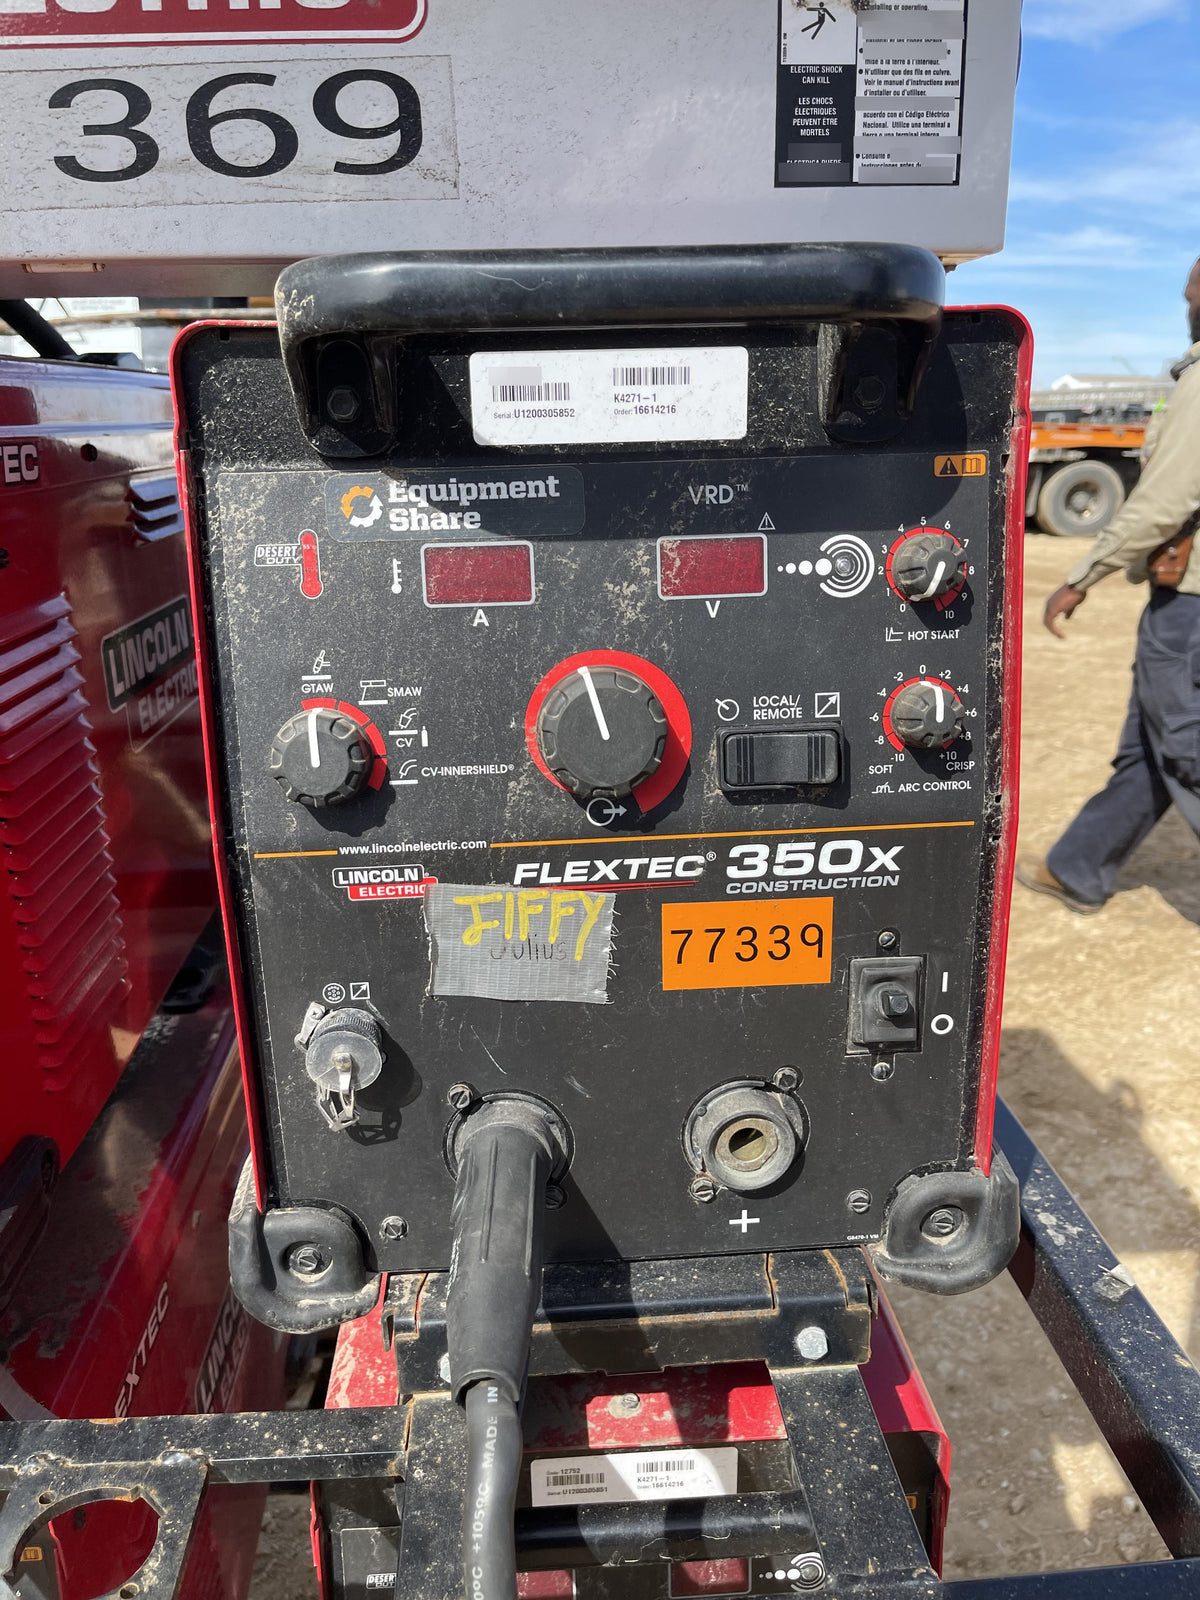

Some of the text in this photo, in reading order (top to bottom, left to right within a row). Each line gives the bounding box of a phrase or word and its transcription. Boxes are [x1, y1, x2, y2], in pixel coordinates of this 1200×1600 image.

[48, 69, 423, 183] 369
[514, 408, 575, 419] U1200305852
[634, 405, 676, 415] 16614216
[0, 444, 39, 484] EC
[388, 475, 560, 508] Equipment
[389, 507, 482, 532] Share
[921, 517, 926, 525] 5
[898, 524, 904, 532] 4
[944, 521, 950, 530] 6
[963, 539, 969, 548] 7
[257, 546, 297, 558] DESERT
[882, 546, 887, 554] 3
[878, 566, 884, 575] 2
[969, 565, 974, 574] 8
[886, 588, 890, 596] 1
[961, 592, 967, 601] 9
[705, 601, 720, 618] V
[900, 604, 906, 613] 0
[473, 610, 489, 627] A
[945, 610, 954, 619] 10
[907, 630, 960, 641] HOT START
[108, 608, 190, 697] LINCOLN
[920, 665, 926, 674] 0
[939, 670, 951, 679] +2
[894, 672, 903, 681] -2
[301, 683, 334, 694] GTAW
[387, 686, 422, 697] SMAW
[877, 688, 887, 697] -4
[957, 684, 969, 694] +4
[138, 658, 198, 733] ELECTRIC
[753, 695, 800, 708] LOCAL/
[753, 707, 802, 720] REMOTE
[869, 713, 879, 722] -6
[965, 708, 977, 717] +6
[875, 736, 884, 745] -8
[959, 732, 971, 741] +8
[396, 738, 412, 747] CV
[891, 753, 904, 762] -10
[939, 751, 957, 760] +10
[868, 765, 893, 775] SOFT
[946, 761, 975, 771] CRISP
[898, 780, 972, 792] ARC CONTROL
[339, 839, 487, 855] www.lincolnelectric.com
[338, 868, 419, 885] LINCOLN
[725, 875, 899, 894] CONSTRUCTION
[670, 924, 824, 965] 77339
[115, 1282, 168, 1418] EXTEC
[488, 1386, 498, 1403] IN
[482, 1416, 498, 1468] MADE
[368, 1574, 396, 1583] DESER
